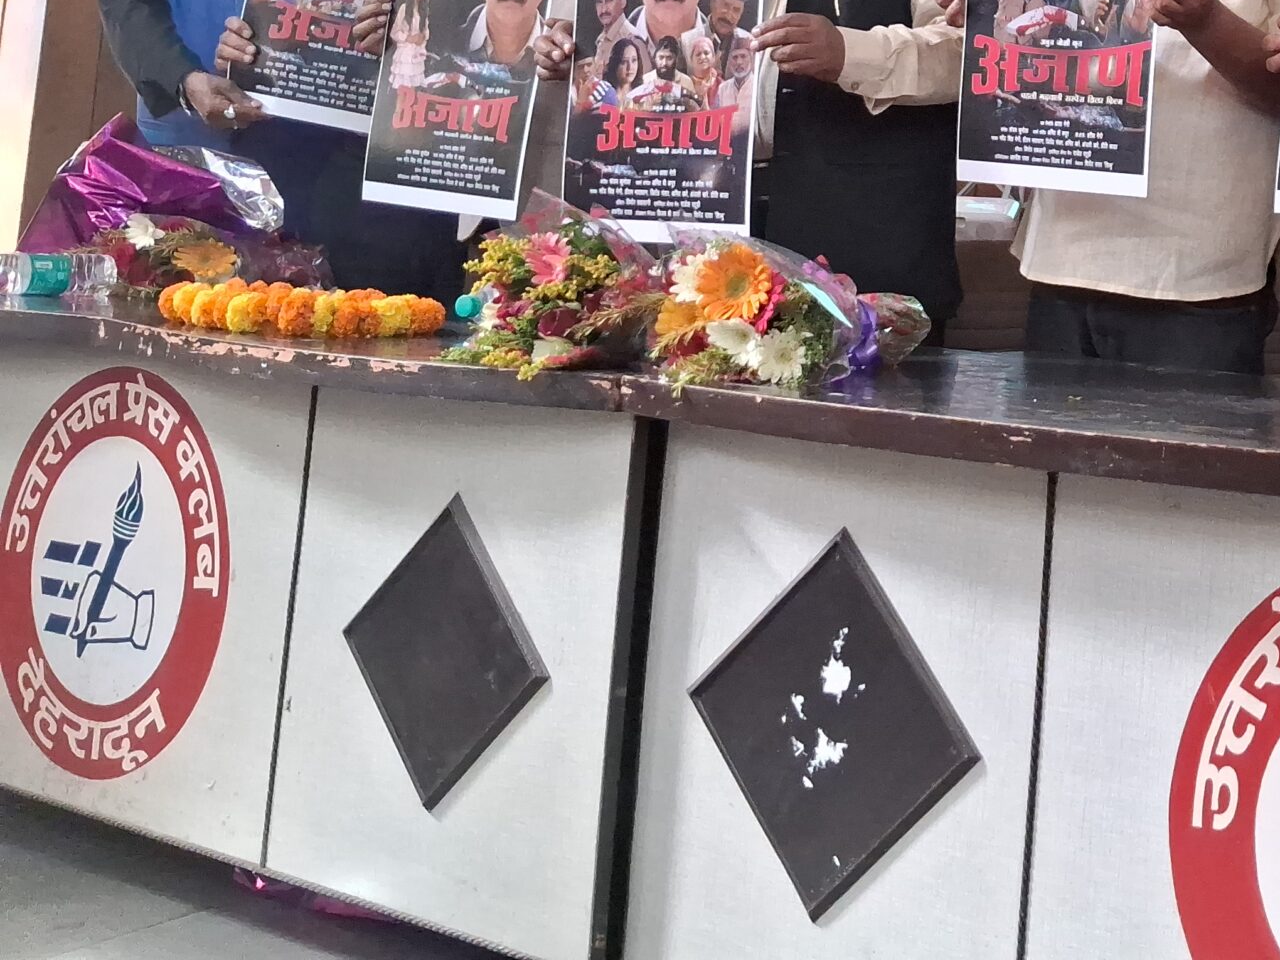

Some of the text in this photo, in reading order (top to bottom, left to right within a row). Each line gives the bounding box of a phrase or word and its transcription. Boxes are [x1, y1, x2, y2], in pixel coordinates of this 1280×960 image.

[971, 34, 1152, 107] अजाण
[392, 85, 519, 143] अजाण
[597, 103, 739, 156] अजाण
[6, 373, 220, 597] उत्तरांचल प्रेस क्लब
[17, 648, 166, 771] देहरादून
